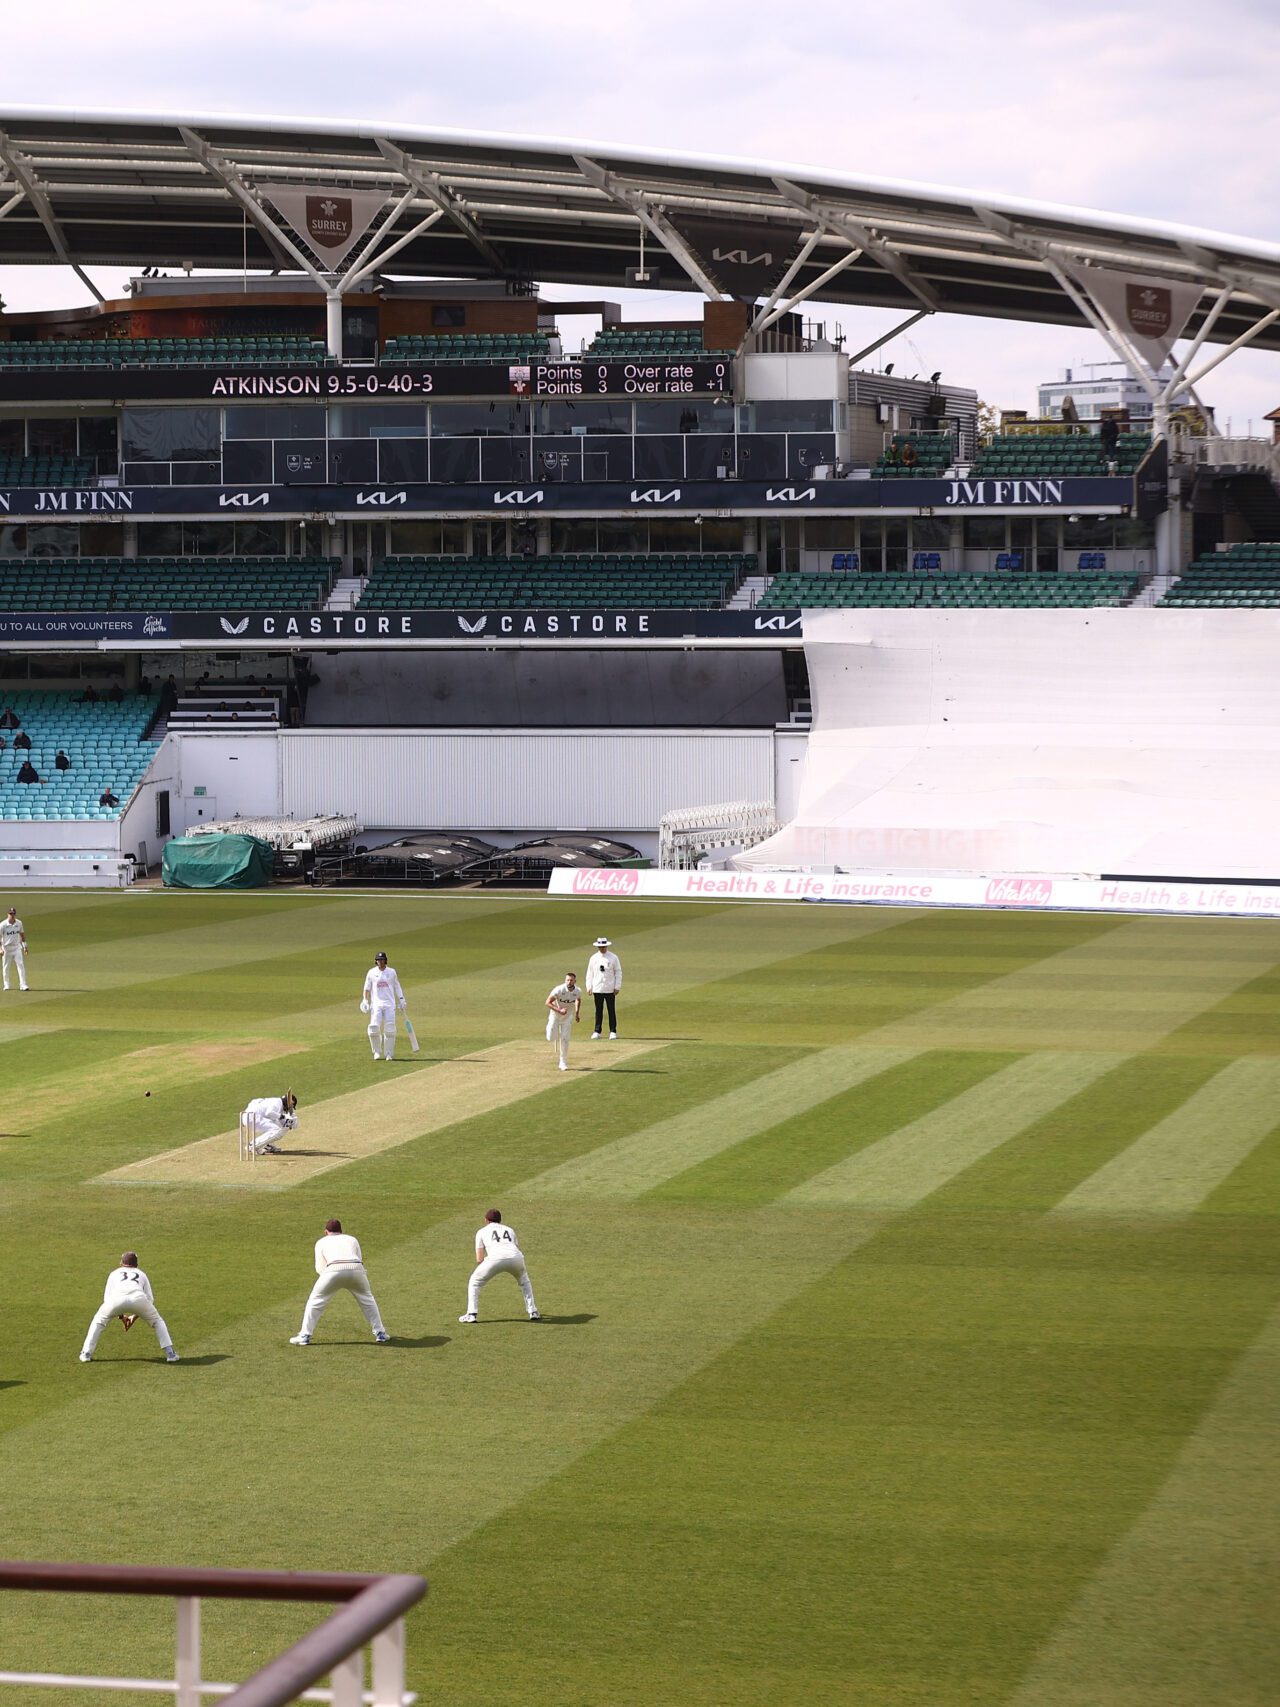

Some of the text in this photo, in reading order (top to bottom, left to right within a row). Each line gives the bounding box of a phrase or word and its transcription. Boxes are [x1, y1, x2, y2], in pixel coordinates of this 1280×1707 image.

[311, 219, 347, 231] SURREY
[537, 364, 725, 380] Points 0 Over rate 0
[212, 374, 433, 395] ATKINSON 9.5-0-40-3
[537, 378, 724, 395] Points 3 Over rate +1
[34, 491, 133, 511] JM FINN
[946, 480, 1063, 505] JM FINN
[9, 622, 23, 631] TO
[25, 622, 43, 631] ALL
[46, 622, 67, 630] OUR
[69, 621, 133, 630] VOLUNTEERS
[263, 616, 411, 633] CASTORE
[501, 615, 649, 633] CASTORE
[575, 869, 932, 898] Vitality Health & Life insurance
[986, 880, 1051, 905] Vitality
[1100, 886, 1172, 905] Health
[1178, 890, 1191, 906] &
[1197, 889, 1237, 908] Life
[491, 1229, 512, 1243] 44
[121, 1271, 140, 1285] 32
